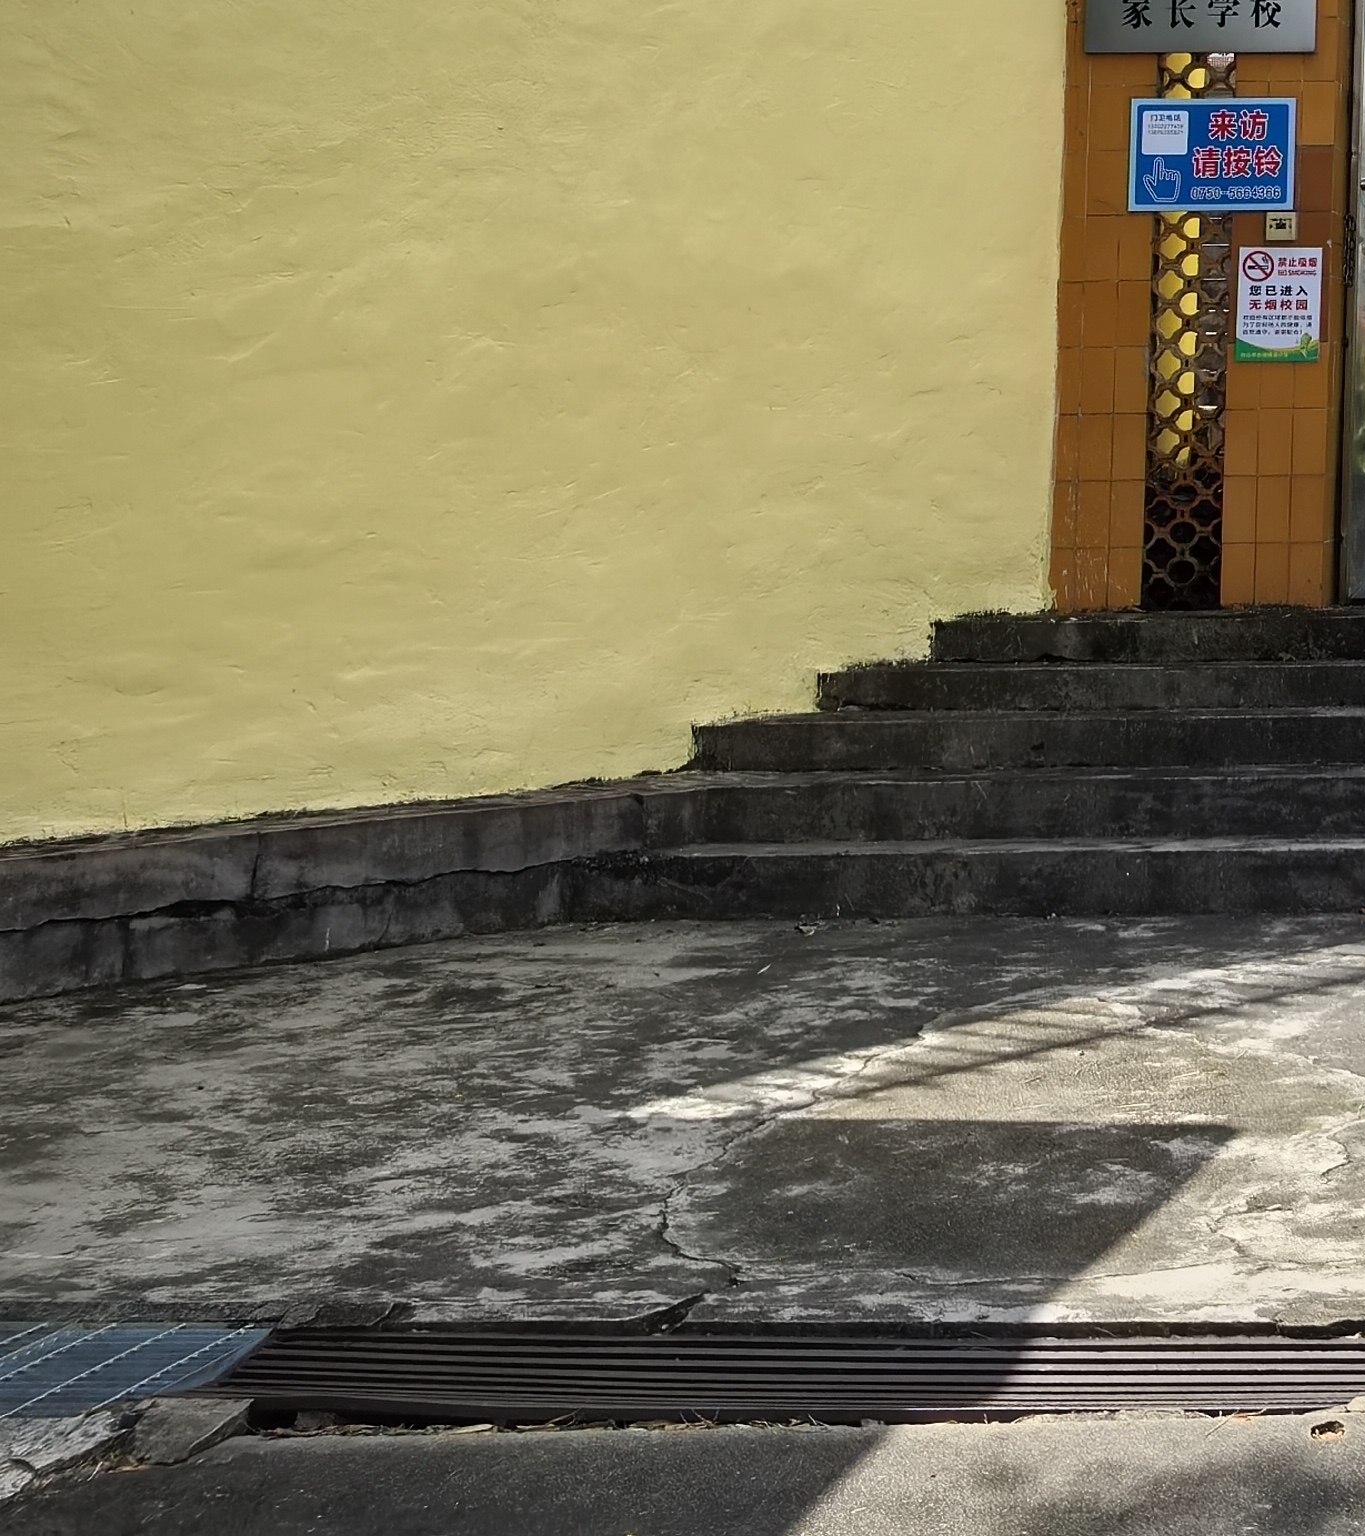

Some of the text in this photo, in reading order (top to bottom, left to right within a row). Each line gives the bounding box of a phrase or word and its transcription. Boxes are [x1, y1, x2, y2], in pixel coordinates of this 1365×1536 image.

[1209, 109, 1268, 141] 来访
[1192, 145, 1284, 179] 请按铃
[1249, 285, 1308, 296] 您已进入
[1249, 299, 1308, 311] 无烟校园
